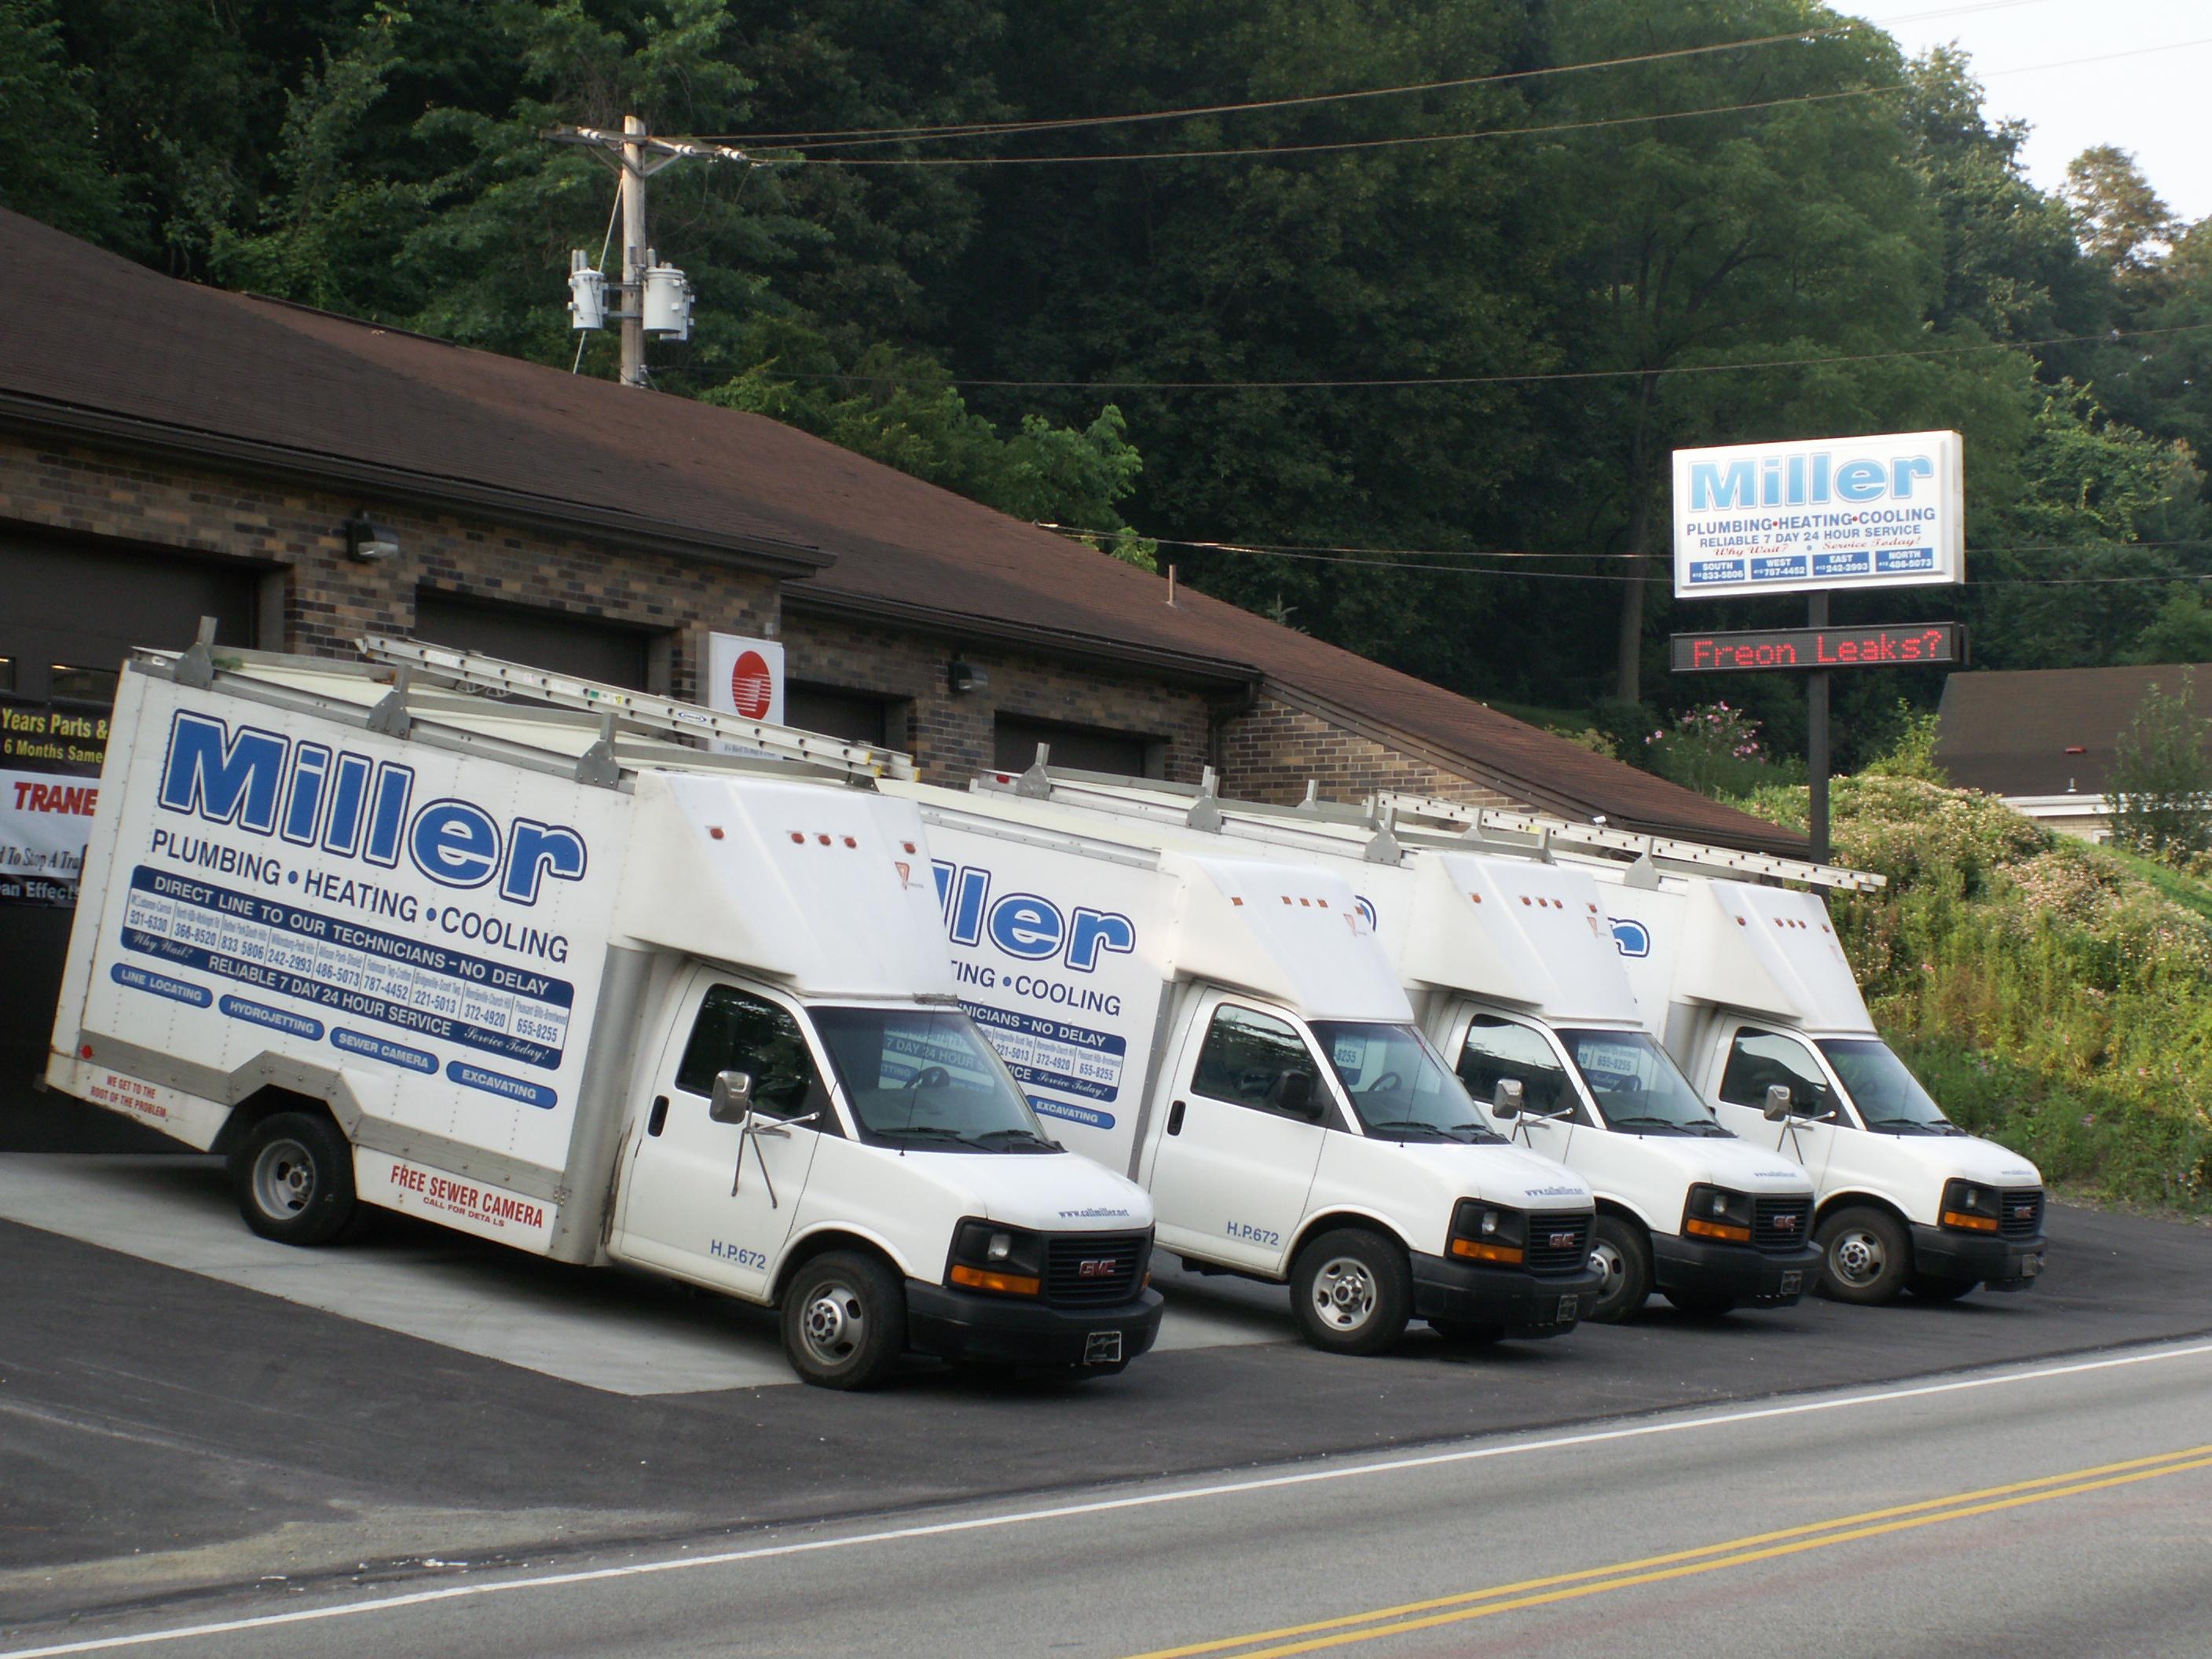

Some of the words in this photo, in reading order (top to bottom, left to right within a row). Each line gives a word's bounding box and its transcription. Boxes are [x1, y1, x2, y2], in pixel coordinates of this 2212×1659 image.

[1688, 452, 1934, 512] Miller
[1686, 518, 1773, 536] PLUMBING
[1778, 513, 1853, 529] HEATING
[1859, 507, 1936, 523] COOLING
[1701, 536, 1759, 548] RELIABLE
[1764, 534, 1771, 544] 7
[1775, 531, 1799, 544] DAY
[1804, 531, 1818, 541] 24
[1824, 529, 1860, 540] HOUR
[1865, 525, 1921, 537] SERVICE
[1822, 541, 1866, 550] Service
[1702, 562, 1733, 571] SOUTH
[1829, 555, 1854, 563] EAST
[1888, 551, 1921, 559] NORTH
[1693, 640, 1796, 668] Freon
[1818, 629, 1942, 663] Leaks?
[2, 709, 45, 734] Years
[50, 713, 92, 739] Parts
[4, 739, 12, 754] 6
[16, 740, 64, 760] Months
[68, 745, 104, 764] Same
[14, 782, 99, 816] TRANE
[157, 709, 588, 906] Miller
[8, 847, 21, 865] To
[48, 851, 57, 868] A
[152, 830, 281, 886] PLUMBING
[303, 869, 418, 923] HEATING
[441, 906, 569, 964] COOLING
[154, 876, 214, 904] DIRECT
[218, 893, 255, 917] LINE
[261, 905, 284, 924] TO
[289, 914, 326, 936] OUR
[332, 925, 446, 969] TECHNICIANS
[459, 959, 486, 979] NO
[492, 969, 550, 995] DELAY
[268, 948, 313, 973] 242-2993
[121, 969, 145, 986] LINE
[149, 976, 202, 1002] LOCATING
[316, 961, 361, 987] 486-5073
[208, 955, 276, 987] RELIABLE
[280, 976, 287, 990] 7
[291, 979, 320, 998] DAY
[321, 987, 339, 1003] 24
[342, 993, 384, 1018] HOUR
[388, 1005, 452, 1036] SERVICE
[364, 975, 408, 1001] 787-4452
[1016, 975, 1122, 1016] COOLING
[414, 990, 456, 1014] 221-5013
[229, 1001, 314, 1034] HYDROJETTING
[464, 1004, 506, 1028] 372-4920
[959, 1003, 1020, 1027] NICIANS
[1031, 1020, 1053, 1036] NO
[1059, 1026, 1106, 1047] DELAY
[517, 1018, 558, 1042] 655-8255
[339, 1033, 378, 1053] SEWER
[381, 1044, 428, 1069] CAMERA
[463, 1025, 504, 1049] Service
[506, 1038, 550, 1063] Today!
[886, 1038, 892, 1048] 7
[895, 1038, 921, 1055] DAY
[922, 1047, 936, 1060] 24
[939, 1050, 974, 1068] HOUR
[1334, 1049, 1357, 1064] -8255
[1037, 1053, 1071, 1070] 372-4920
[1079, 1063, 1114, 1081] 655-8255
[107, 1075, 117, 1087] WE
[119, 1079, 131, 1091] GET
[133, 1082, 141, 1095] TO
[143, 1086, 156, 1099] THE
[461, 1068, 537, 1101] EXCAVATING
[110, 1092, 119, 1103] OF
[120, 1095, 133, 1108] THE
[134, 1099, 167, 1118] PROBLEM
[1037, 1101, 1098, 1122] EXCAVATING
[390, 1165, 425, 1192] FREE
[429, 1177, 478, 1209] SEWER
[482, 1192, 544, 1229] CAMERA
[423, 1196, 445, 1210] CALL
[447, 1203, 466, 1215] FOR
[468, 1210, 505, 1227] DETALS
[1227, 1221, 1280, 1247] H.P.672
[710, 1239, 767, 1269] H.P.672
[1079, 1260, 1115, 1276] GMC
